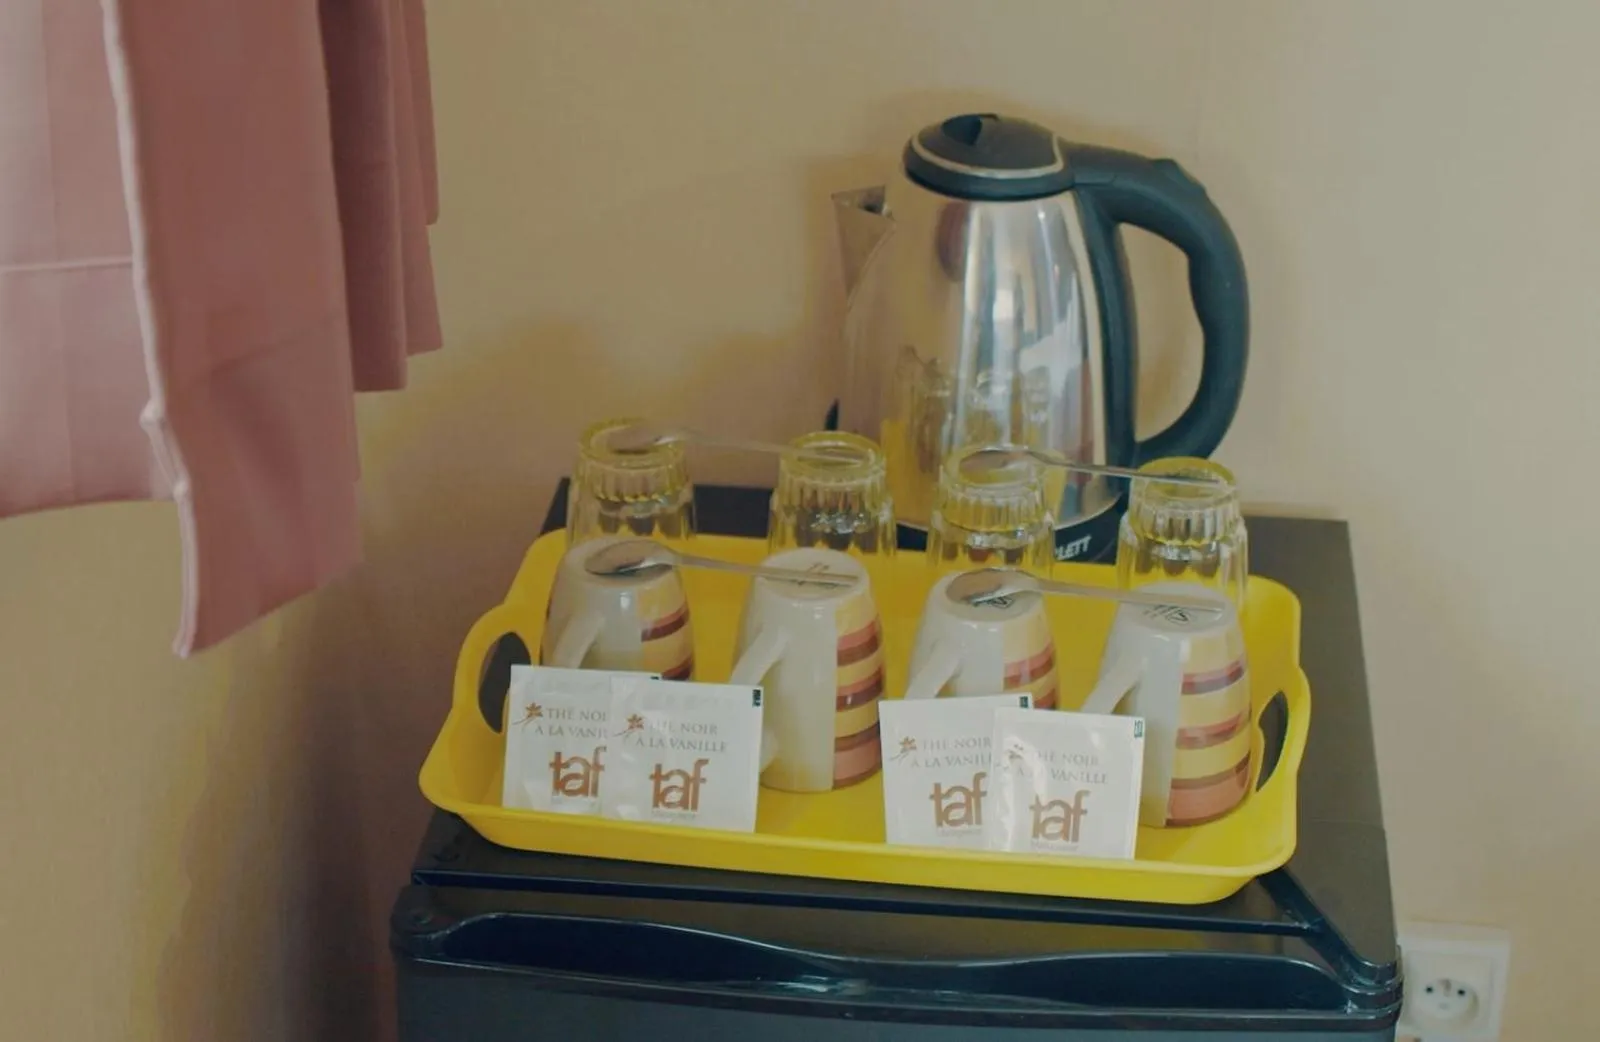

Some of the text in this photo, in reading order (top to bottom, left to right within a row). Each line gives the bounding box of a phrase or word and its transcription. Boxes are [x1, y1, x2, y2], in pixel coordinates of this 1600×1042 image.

[548, 725, 564, 736] LA
[681, 722, 718, 735] NOIR
[649, 737, 665, 748] LA
[669, 737, 727, 752] VANILLE
[954, 736, 992, 748] NOIR
[925, 757, 941, 768] LA
[1062, 752, 1099, 766] NOIR
[549, 746, 607, 798] taf
[1050, 767, 1108, 784] VANILLE
[649, 759, 709, 812] taf
[929, 772, 987, 827] taf
[1029, 789, 1091, 843] taf
